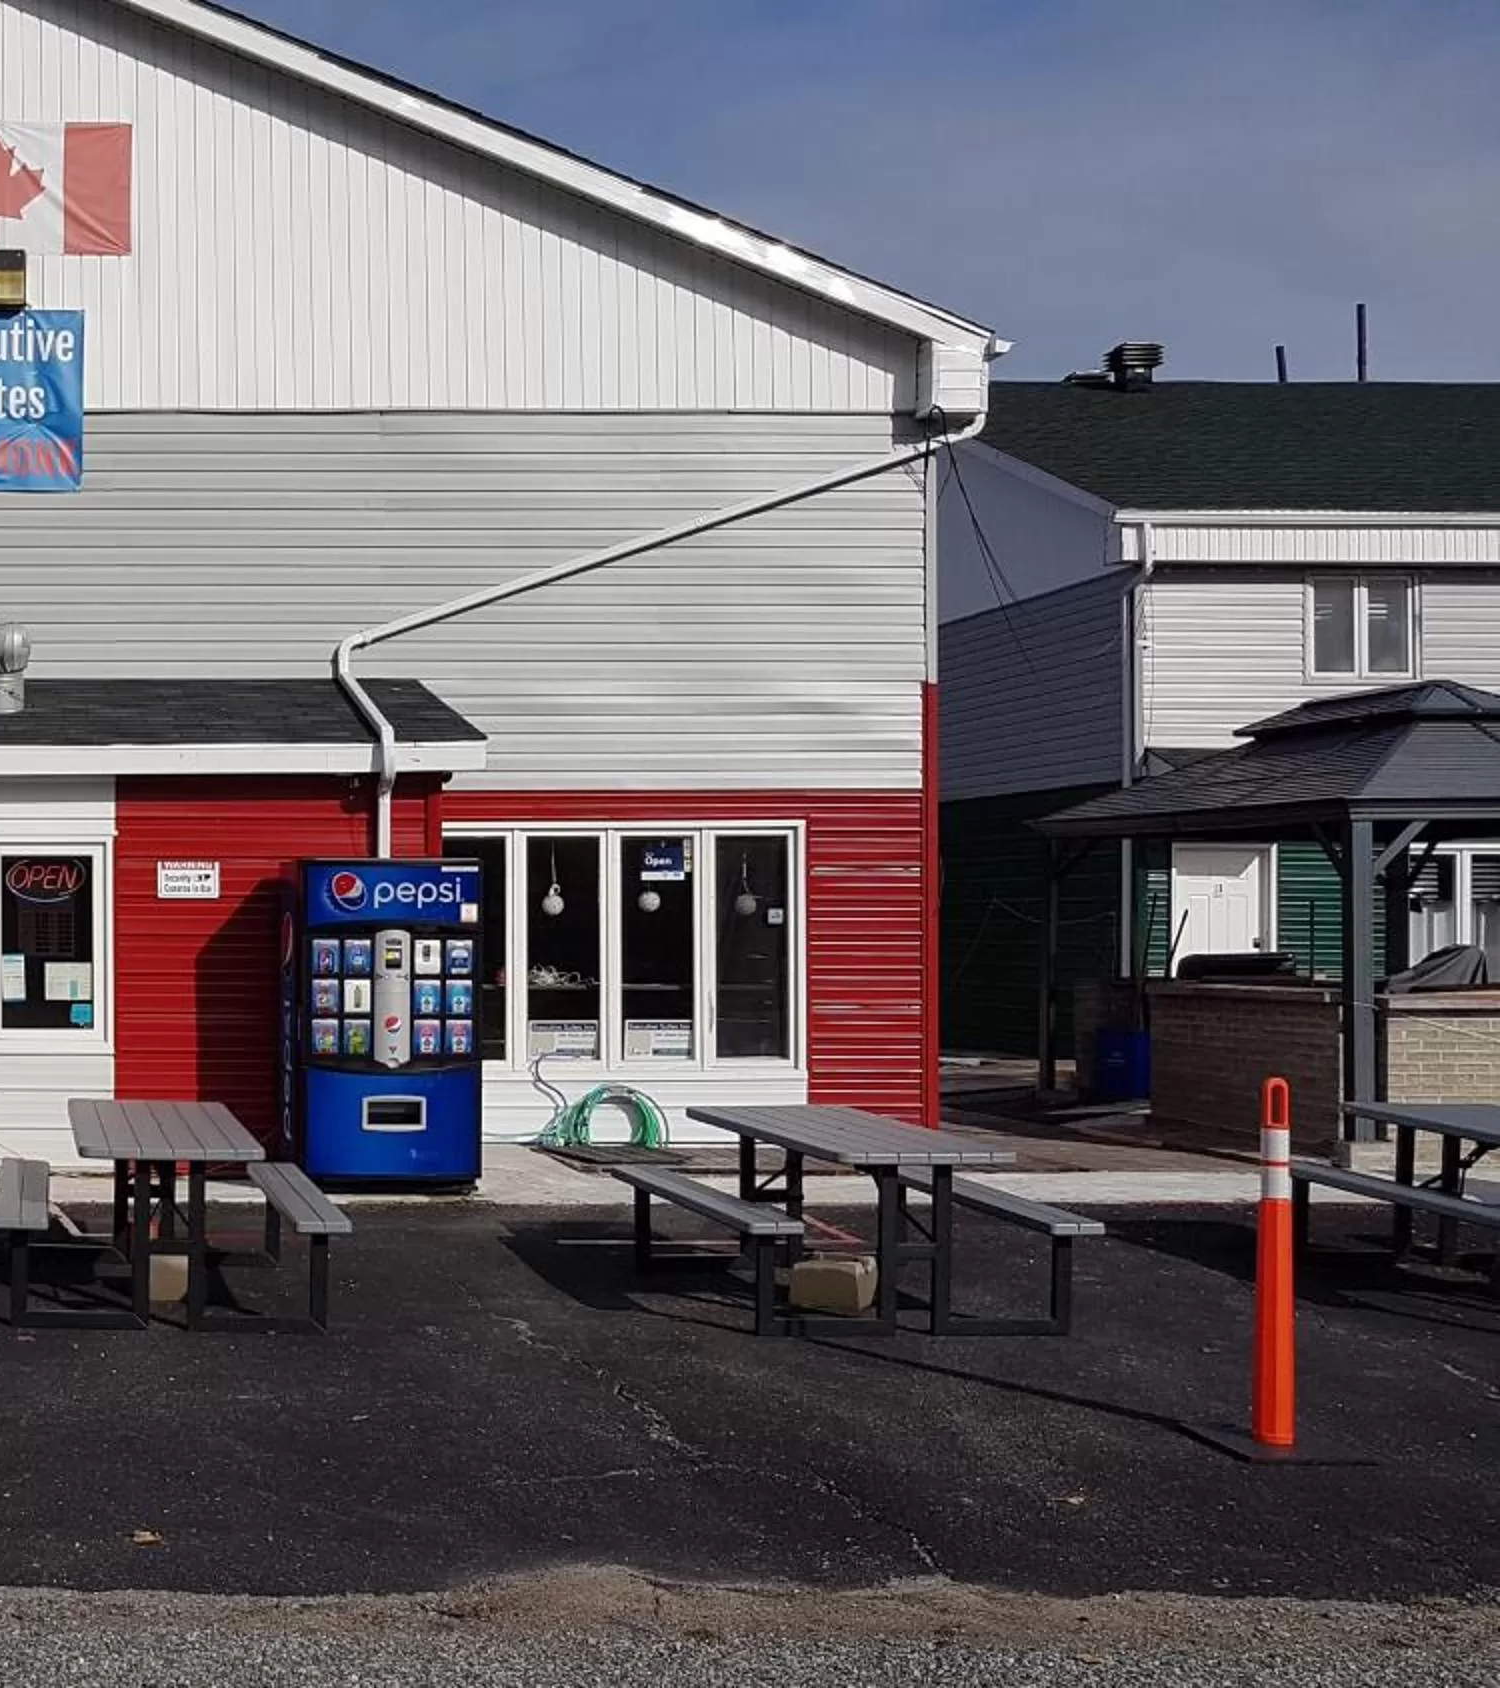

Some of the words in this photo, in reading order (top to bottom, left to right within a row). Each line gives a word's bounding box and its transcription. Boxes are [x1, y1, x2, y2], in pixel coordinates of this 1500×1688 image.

[644, 856, 673, 868] Open
[11, 864, 78, 889] OPEN
[373, 876, 462, 909] pepsi
